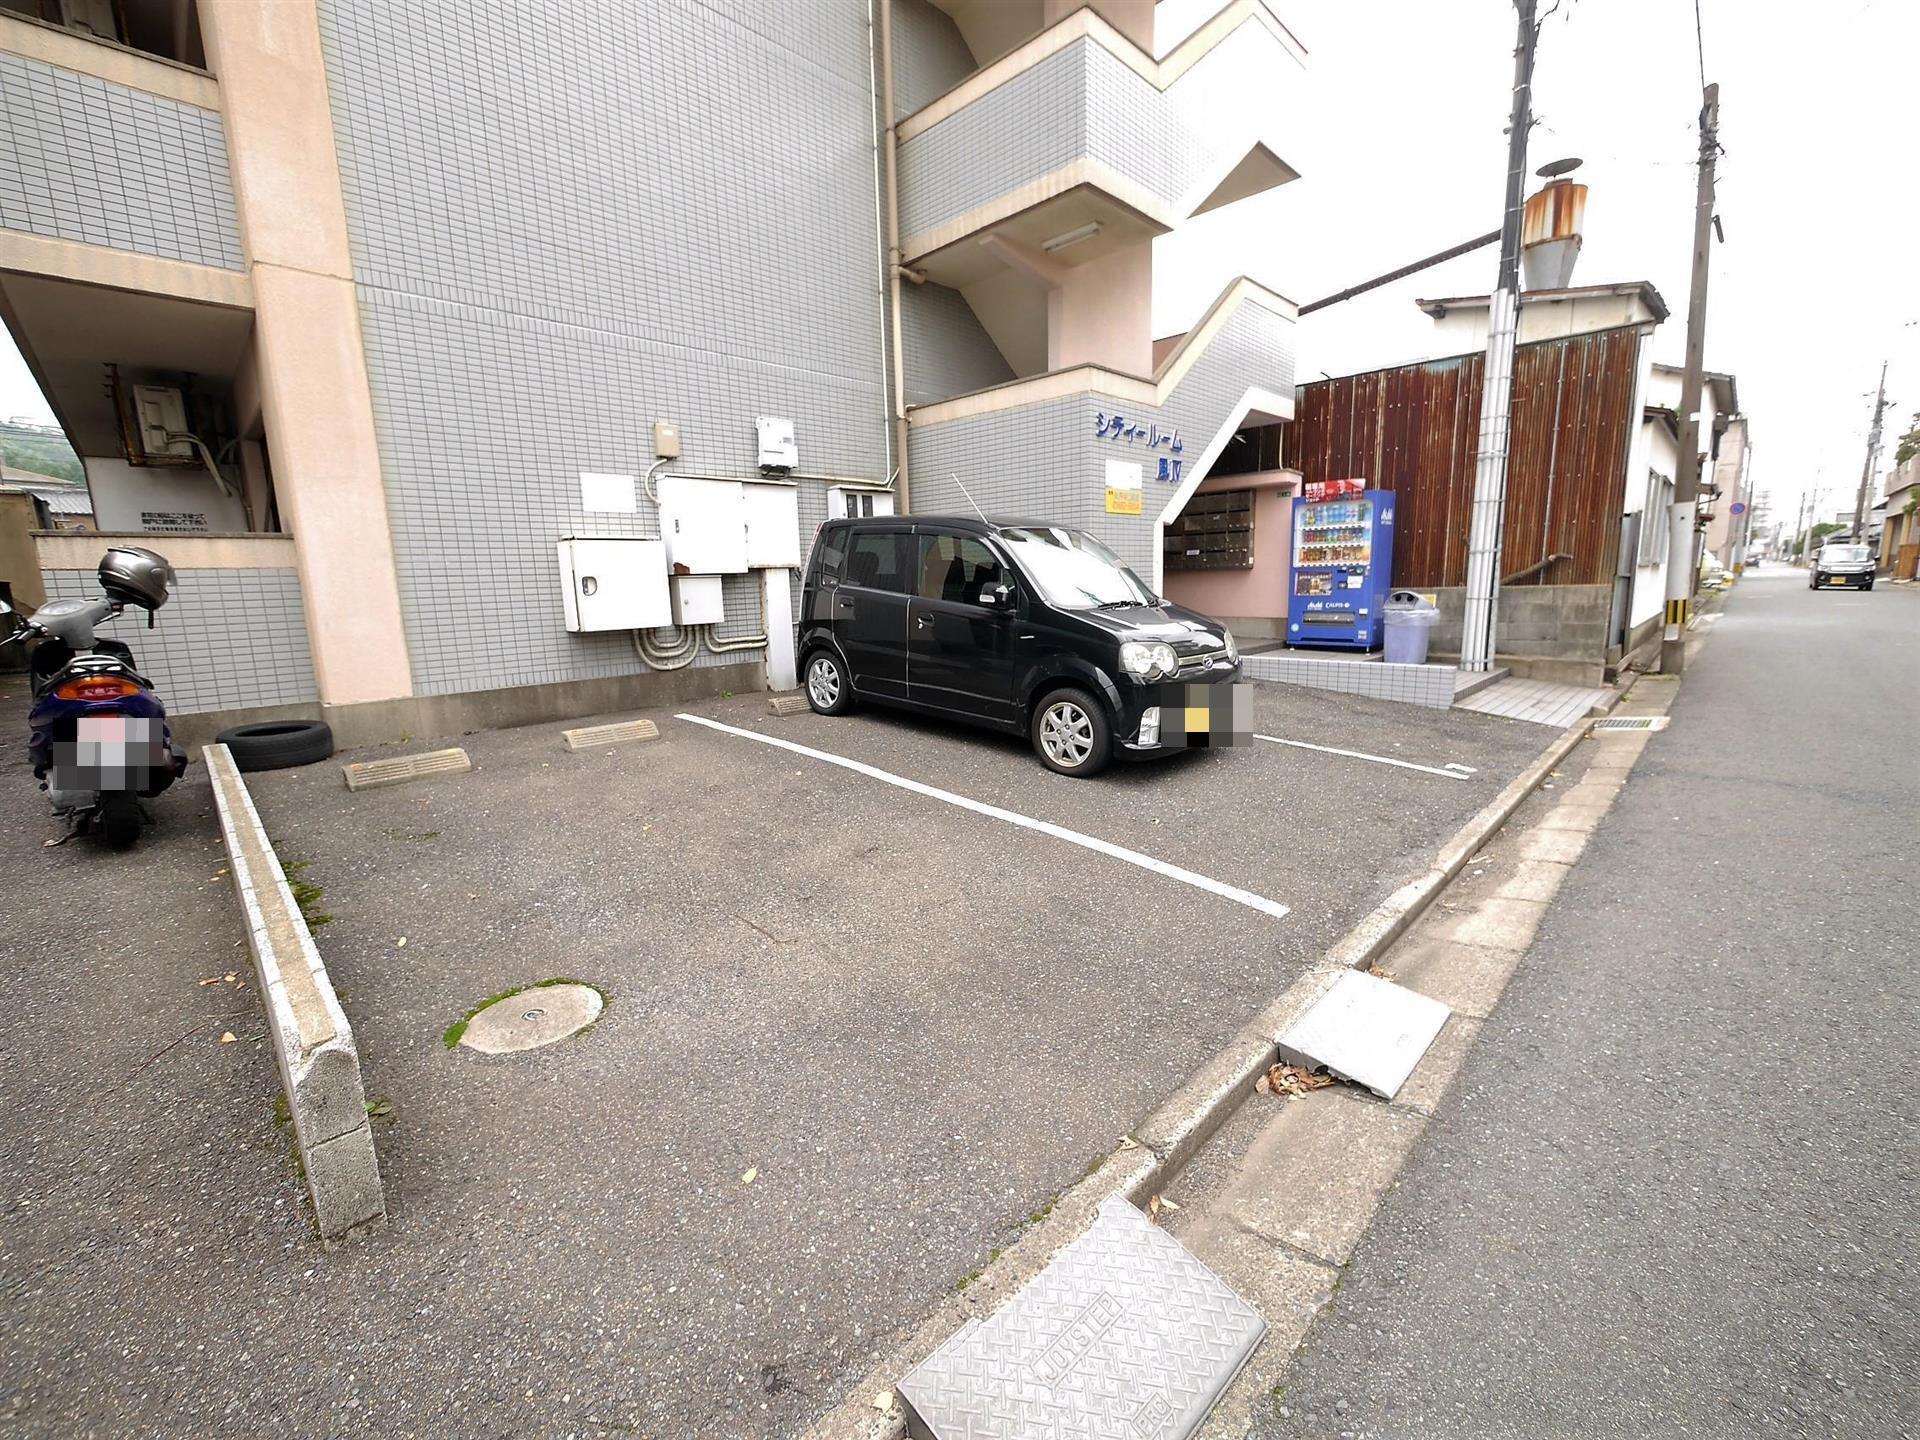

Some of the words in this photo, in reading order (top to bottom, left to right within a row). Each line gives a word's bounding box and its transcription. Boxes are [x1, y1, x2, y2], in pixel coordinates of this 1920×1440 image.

[1095, 411, 1183, 453] シティールーム
[1042, 1298, 1116, 1380] JOYSTEP
